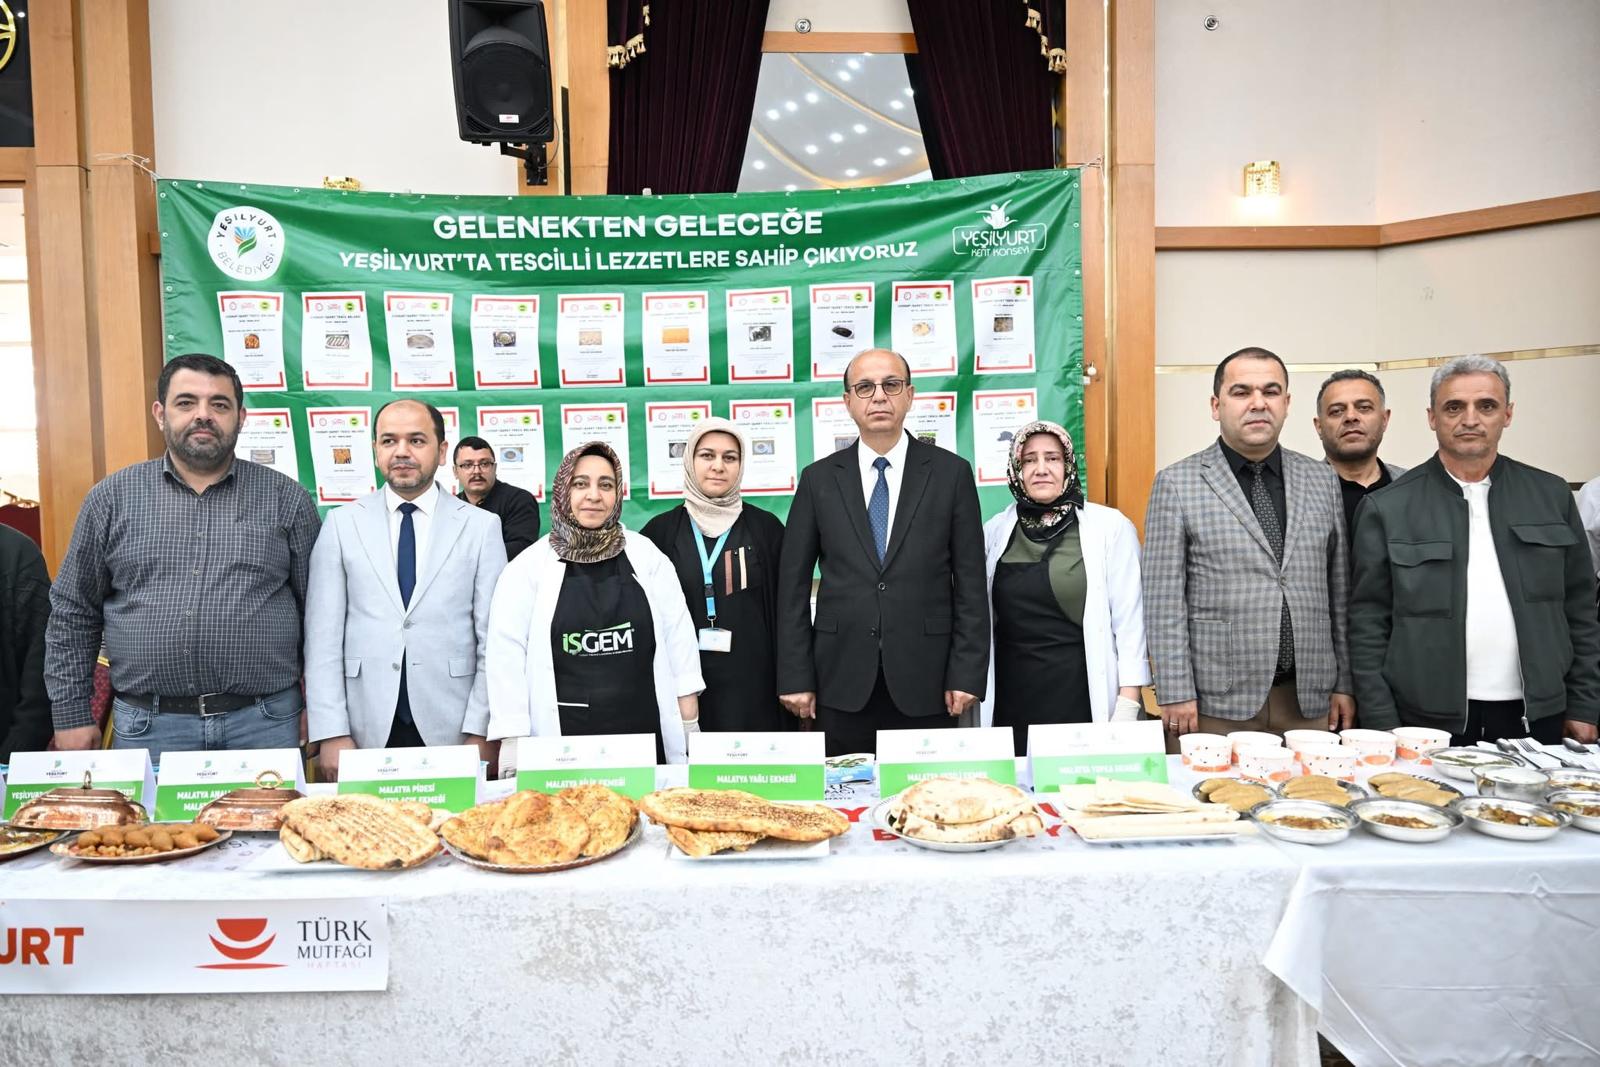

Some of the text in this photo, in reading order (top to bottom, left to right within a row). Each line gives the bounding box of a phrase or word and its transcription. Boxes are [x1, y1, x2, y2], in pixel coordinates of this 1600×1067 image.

[432, 207, 822, 239] GELENEKTEN GELECEĞE
[961, 229, 1038, 250] YEŞİLYURT
[339, 241, 918, 272] YEŞİLYURT'TA TESCİLLİ LEZZETLERE SAHİP ÇIKIYORUZ
[378, 782, 436, 794] MALATYA PİDESİ
[716, 775, 748, 784] MALATYA
[769, 773, 797, 784] EKMEĞİ
[177, 790, 209, 800] MALATYA
[297, 916, 372, 942] TÜRK
[297, 942, 373, 960] MUTFAĞI
